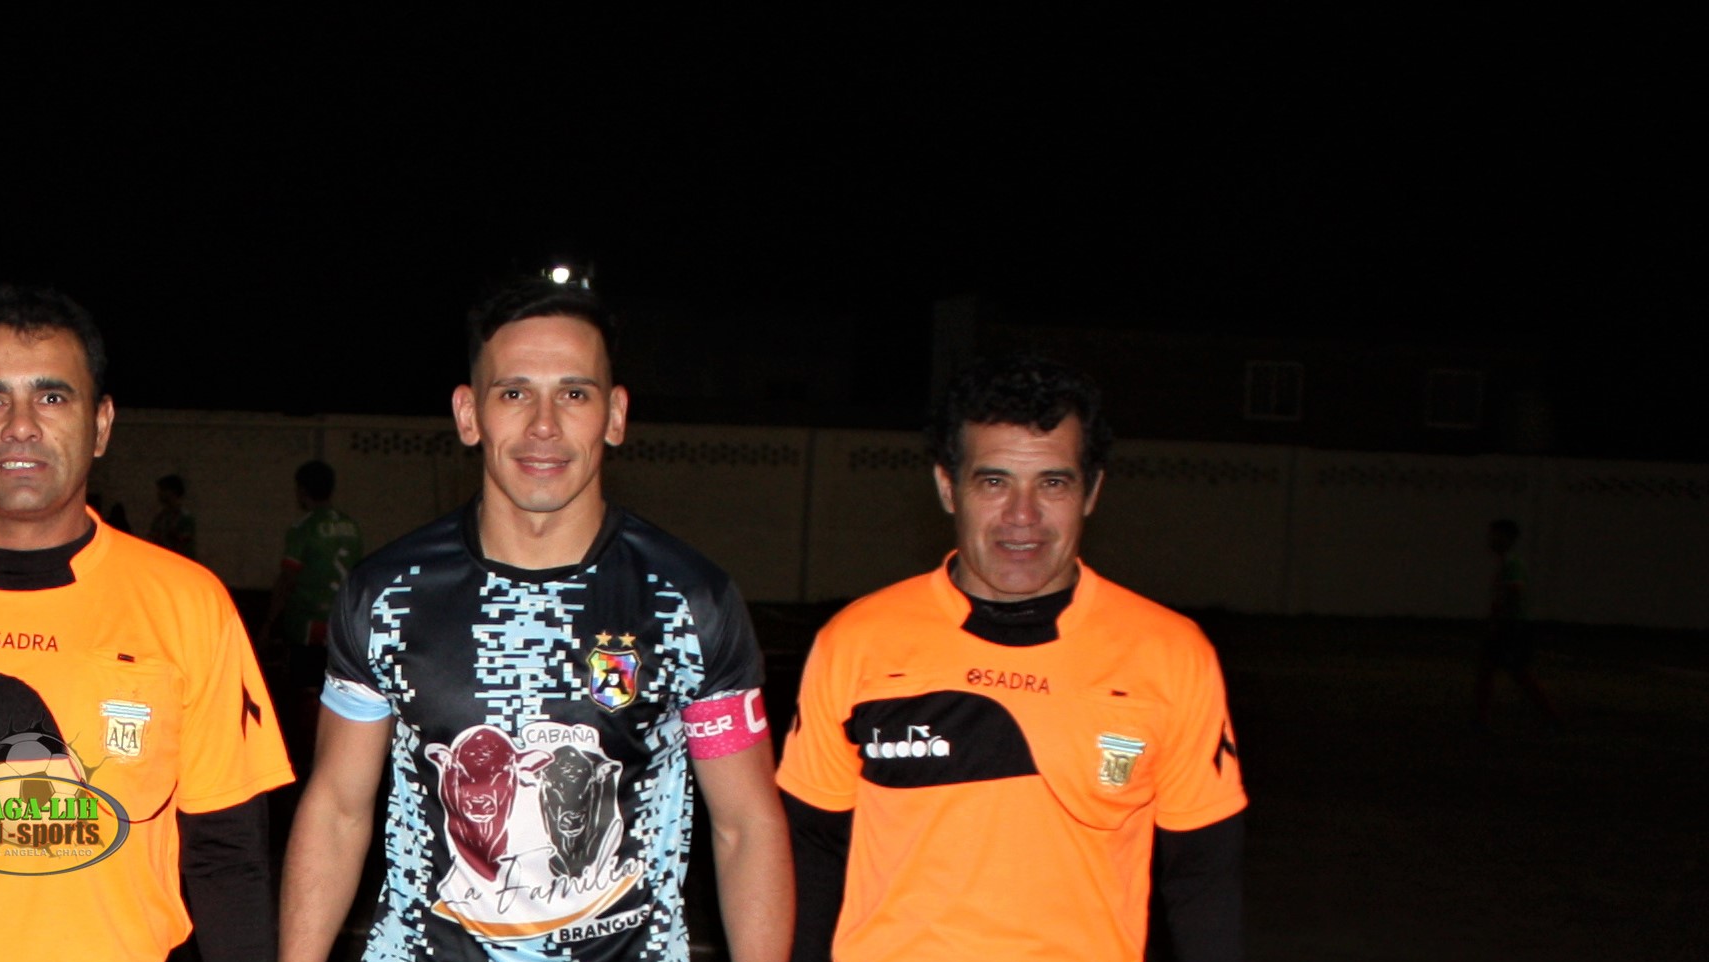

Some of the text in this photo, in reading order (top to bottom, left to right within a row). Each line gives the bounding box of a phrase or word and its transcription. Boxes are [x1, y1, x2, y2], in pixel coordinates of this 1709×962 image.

[982, 669, 1051, 695] SADRA
[525, 726, 596, 744] CABAÑA
[558, 905, 654, 942] BRANGUS
